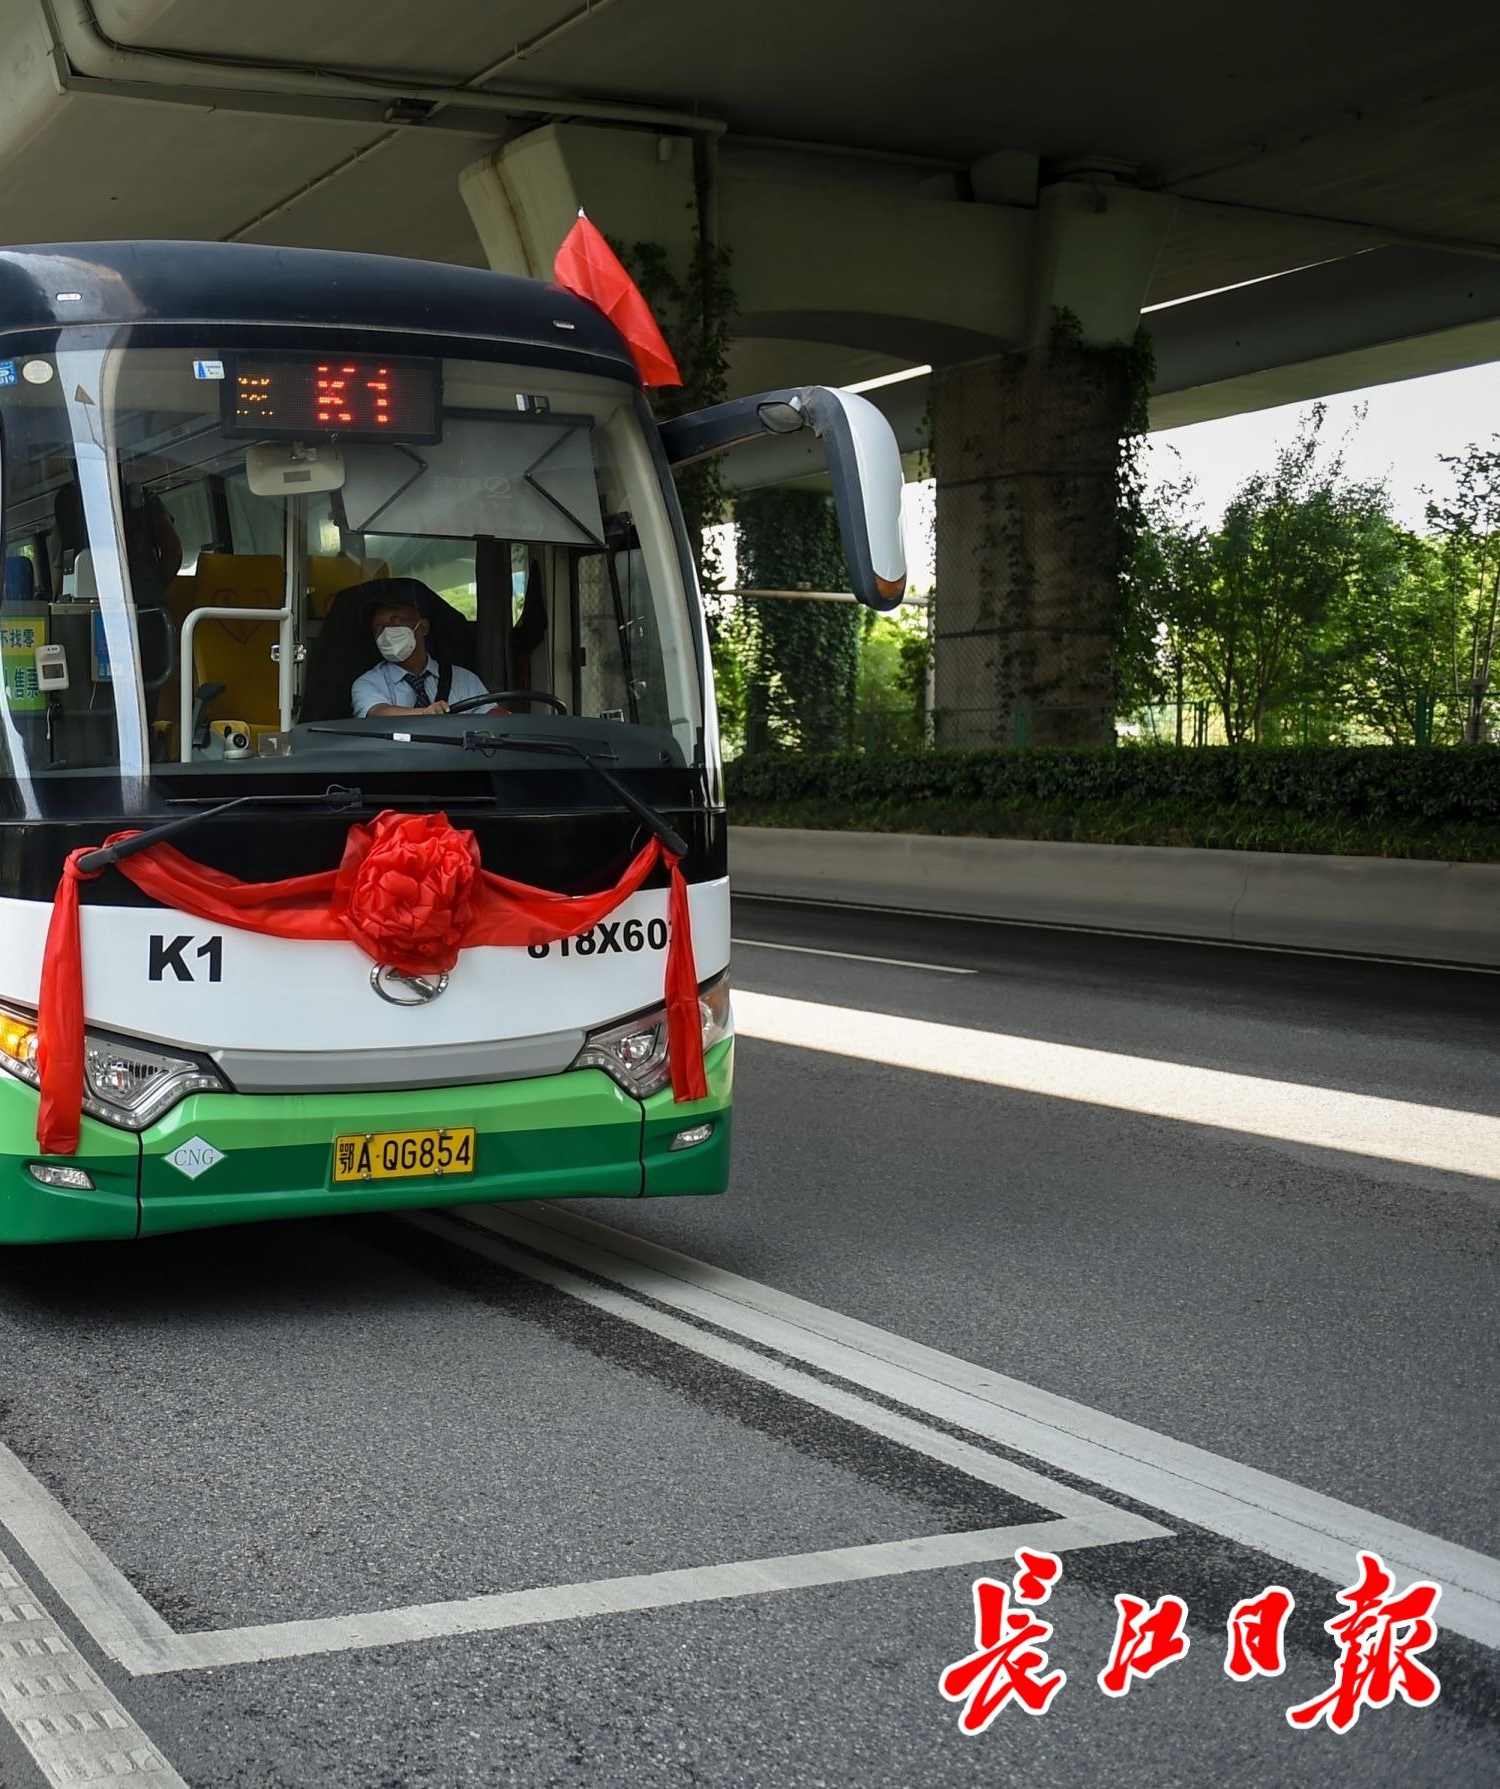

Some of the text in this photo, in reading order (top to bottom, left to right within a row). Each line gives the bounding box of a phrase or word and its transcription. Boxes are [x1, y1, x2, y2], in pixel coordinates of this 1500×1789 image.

[317, 365, 388, 423] K1
[147, 935, 224, 983] K1
[527, 917, 673, 960] 818X60
[174, 1148, 215, 1167] CNG
